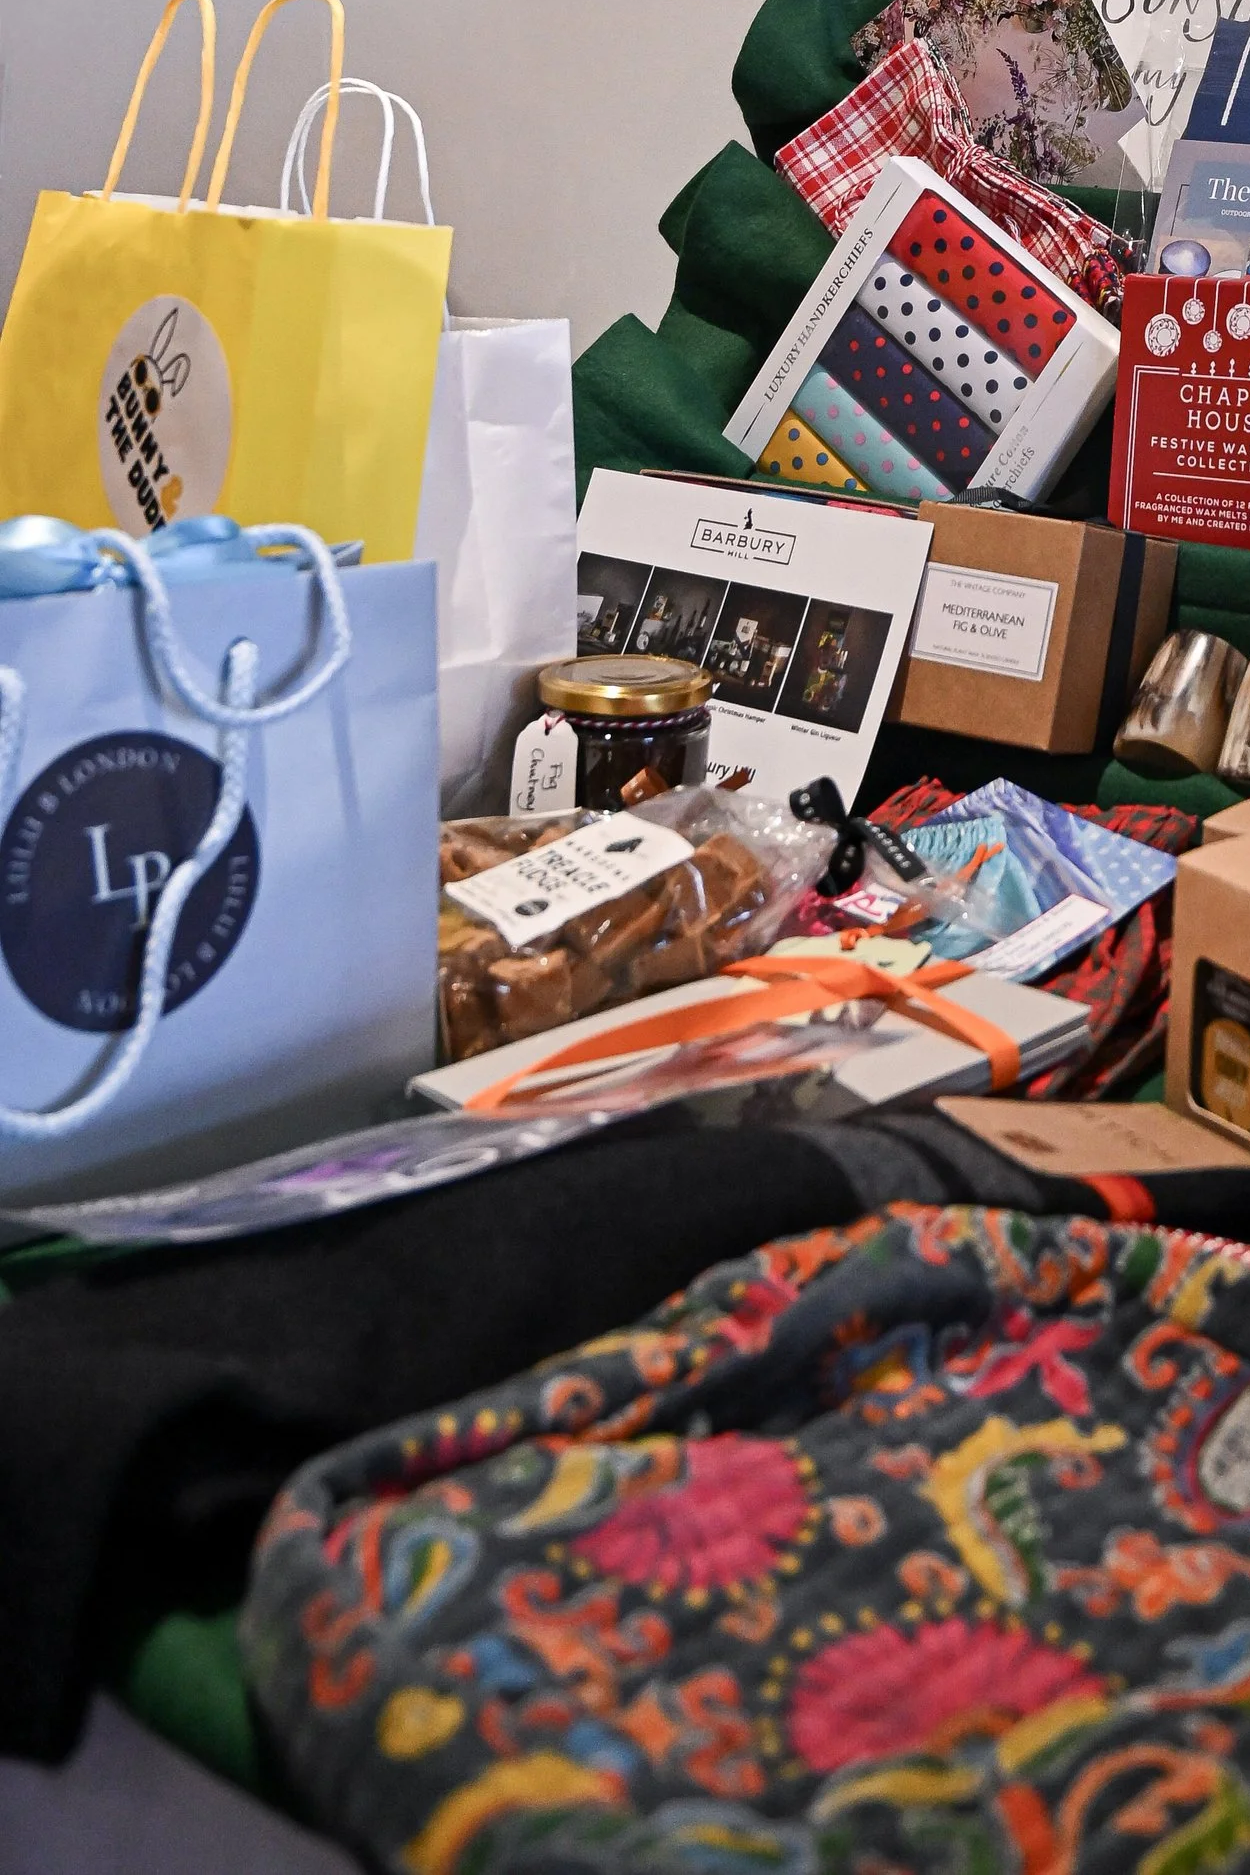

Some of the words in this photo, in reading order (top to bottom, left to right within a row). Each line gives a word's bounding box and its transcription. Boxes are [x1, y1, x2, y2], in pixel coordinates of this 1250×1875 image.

[1134, 60, 1187, 126] my
[1208, 178, 1250, 202] The
[1221, 209, 1250, 218] OUTDOOR
[764, 340, 804, 403] LUXURY
[796, 226, 875, 349] HANDKERCHIEFS
[106, 395, 133, 463] THE
[117, 372, 169, 482] BUNNY
[1151, 437, 1215, 452] FESTIVE
[985, 467, 1001, 487] ure
[1135, 502, 1193, 515] FRAGRANCED
[1195, 507, 1216, 517] WAX
[1219, 509, 1247, 520] MELTS
[1156, 493, 1163, 501] A
[1164, 493, 1219, 506] COLLECTION
[1222, 499, 1233, 507] OF
[1236, 500, 1245, 509] 12
[1158, 514, 1169, 523] BY
[1171, 515, 1183, 524] ME
[1186, 517, 1204, 526] AND
[1206, 519, 1247, 531] CREATED
[701, 529, 785, 555] BARBURY
[728, 551, 750, 560] HILL
[942, 603, 1025, 626] MEDITERRANEAN
[953, 620, 968, 631] FIG
[970, 625, 976, 633] &
[980, 625, 1008, 639] OLIVE
[718, 706, 744, 717] Christmas
[745, 712, 766, 723] Hamper
[791, 725, 809, 734] Winter
[810, 728, 819, 736] Gin
[820, 731, 841, 741] Liqueur
[517, 748, 544, 811] Chutney
[542, 762, 563, 790] Fig
